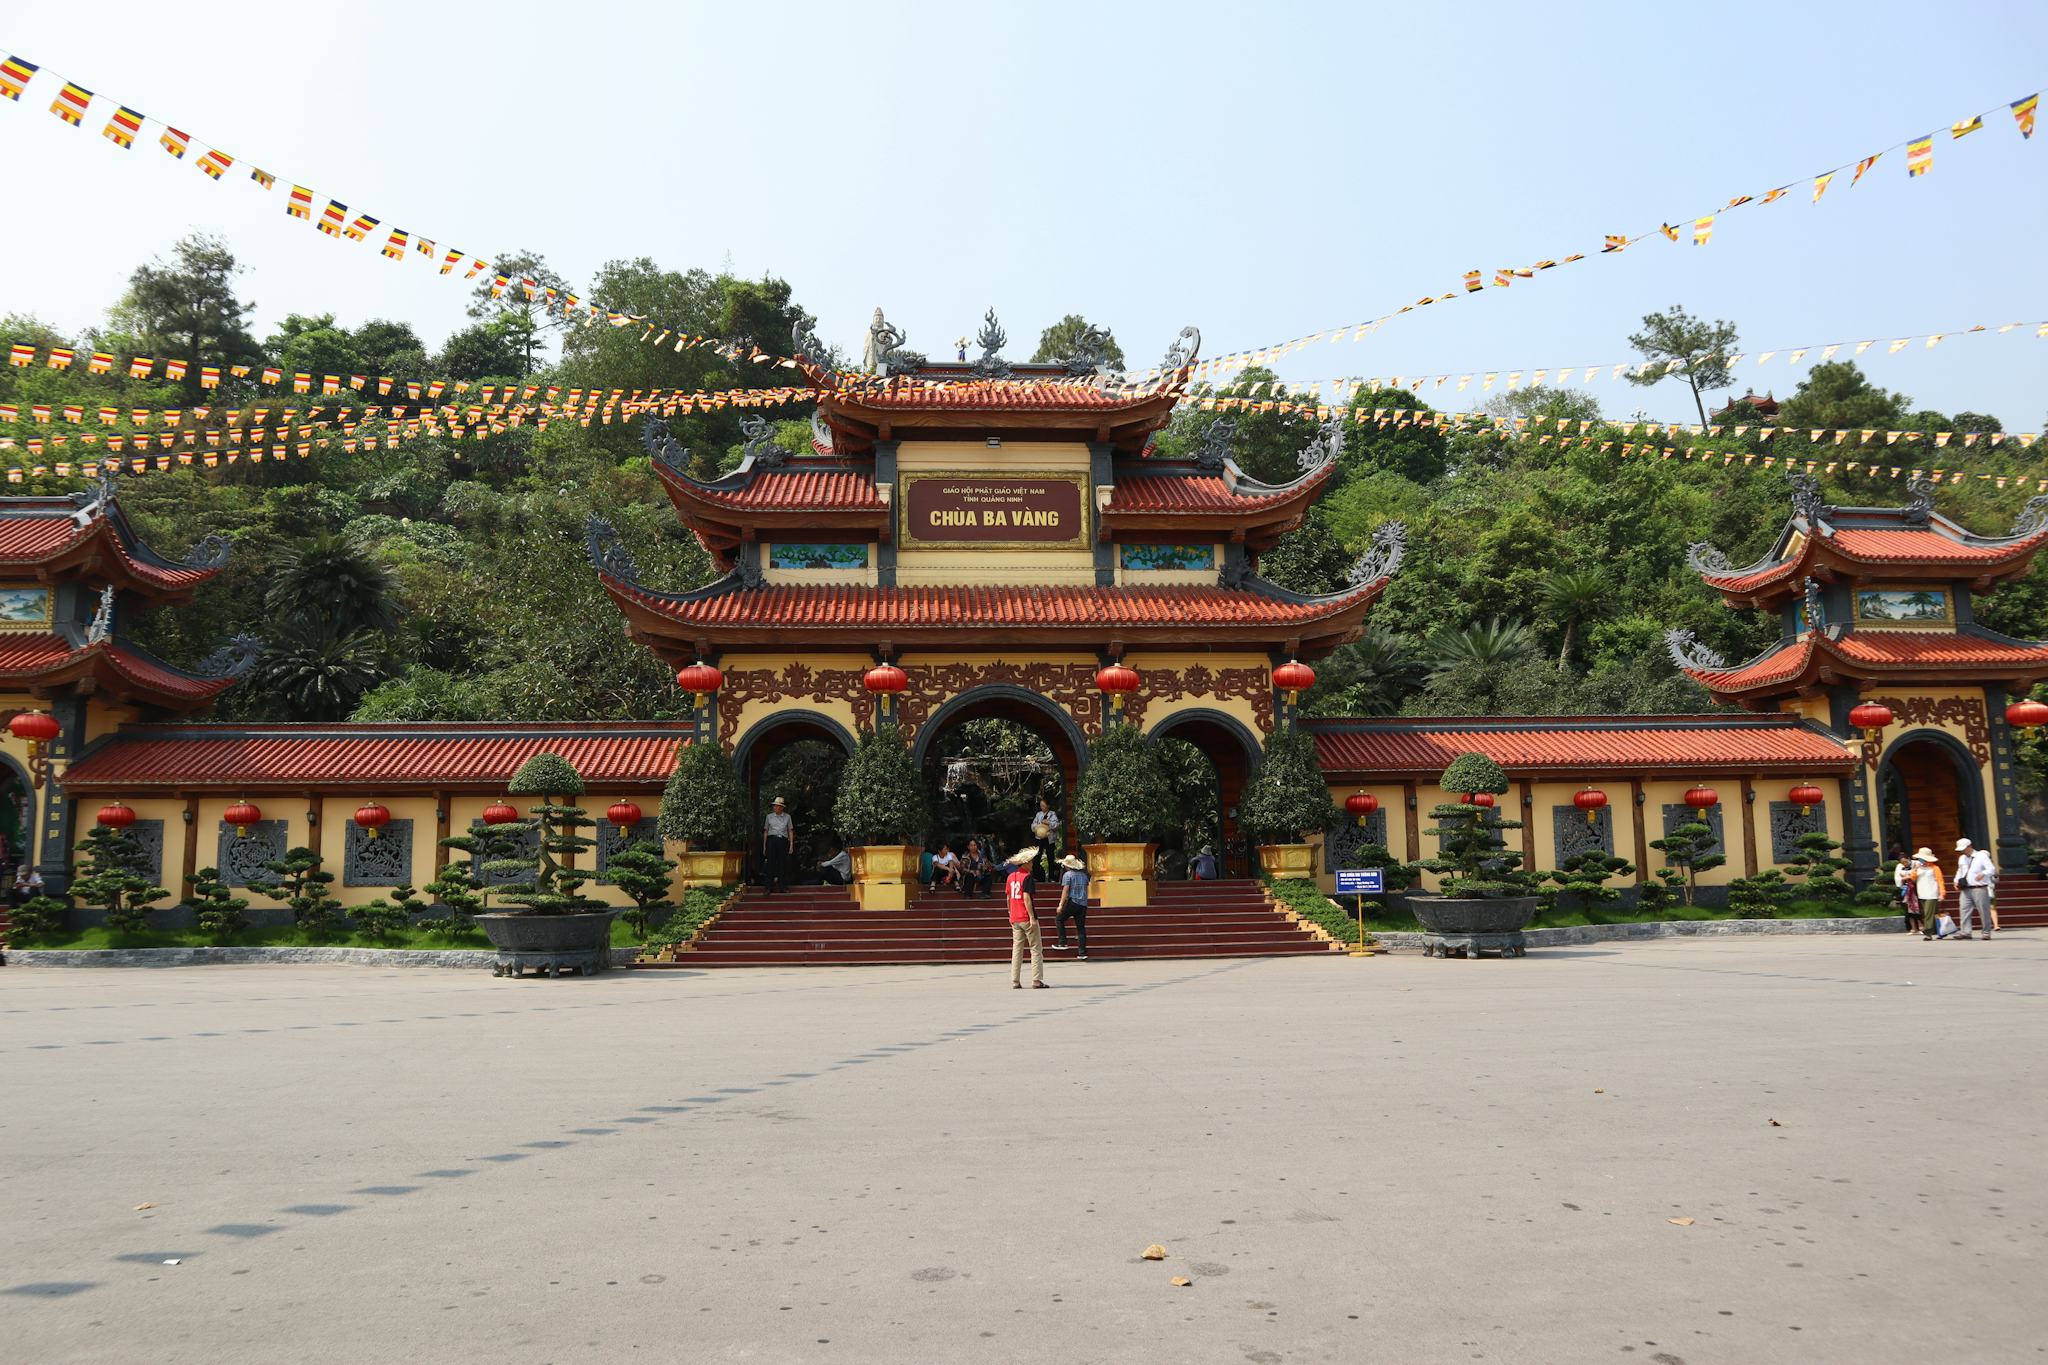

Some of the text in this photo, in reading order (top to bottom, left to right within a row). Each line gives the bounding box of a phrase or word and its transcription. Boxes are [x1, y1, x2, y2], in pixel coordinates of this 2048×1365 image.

[943, 486, 960, 494] GIÁO
[975, 486, 993, 496] PHẬT
[994, 486, 1011, 494] GIÁO
[1013, 486, 1028, 496] VIỆT
[930, 507, 1059, 526] CHÙA BA VÀNG
[1010, 881, 1021, 899] 12
